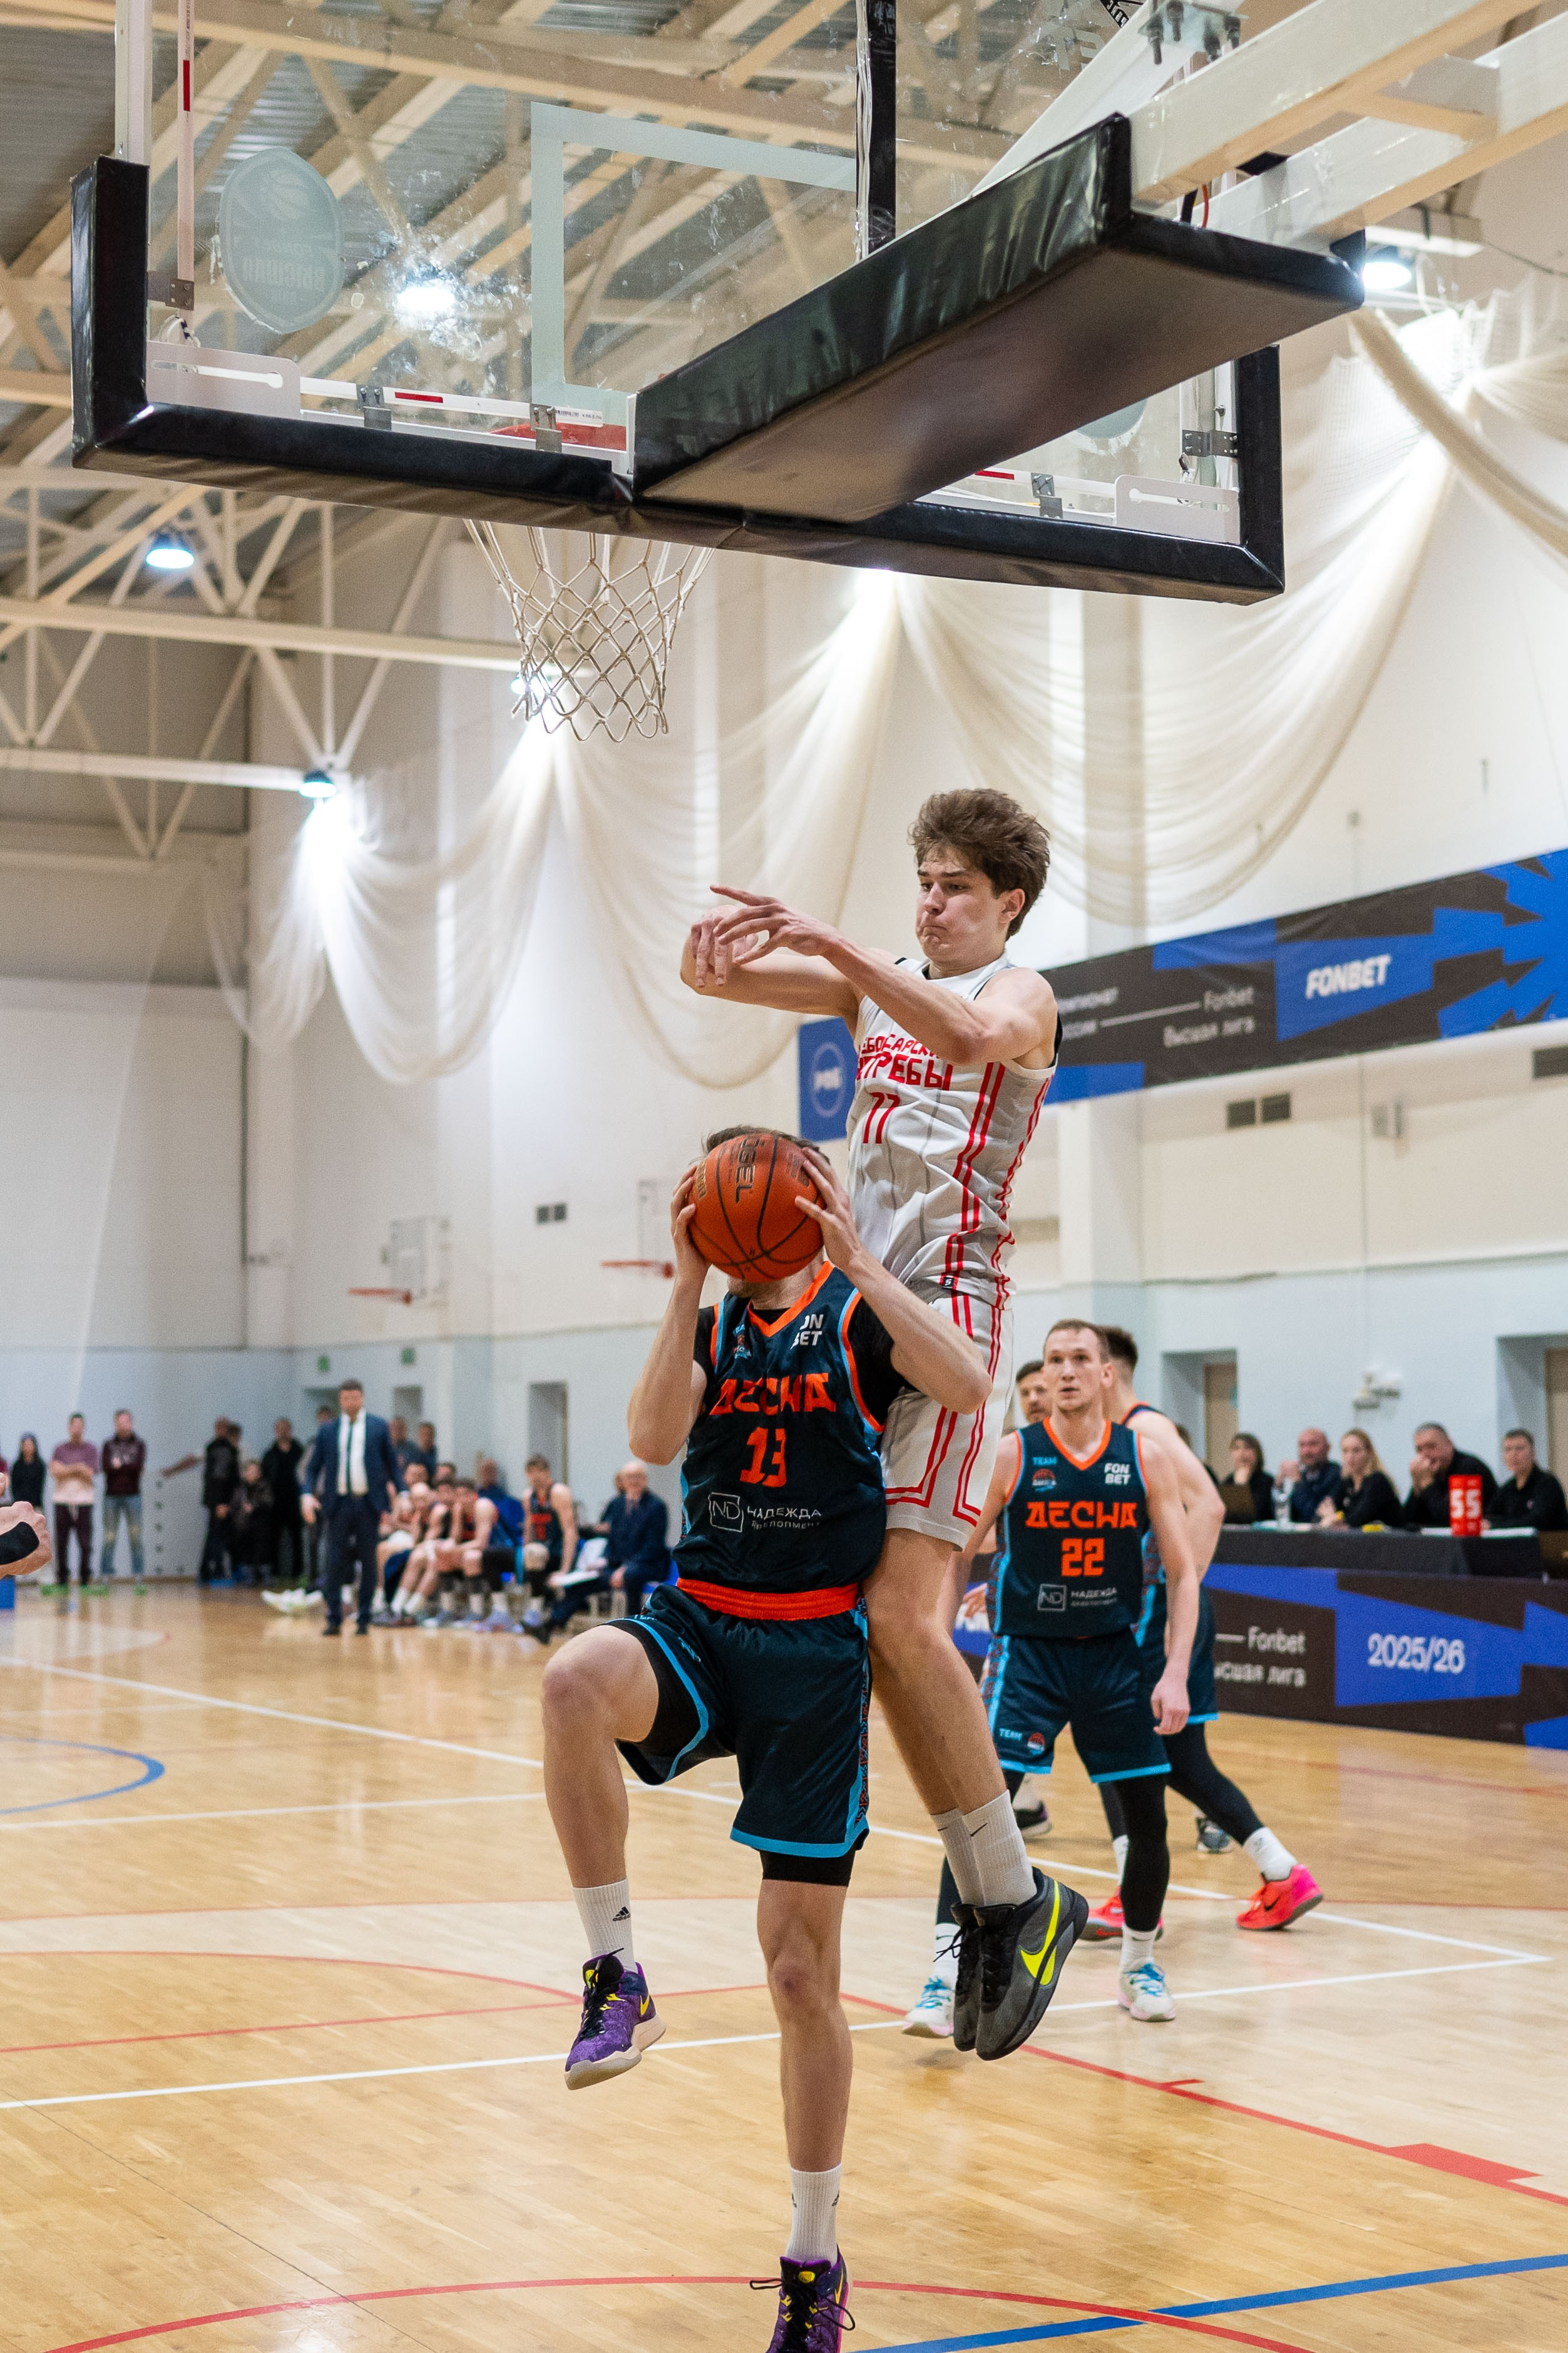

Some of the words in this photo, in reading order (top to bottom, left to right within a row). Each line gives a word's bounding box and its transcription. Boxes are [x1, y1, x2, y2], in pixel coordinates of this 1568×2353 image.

[1306, 954, 1390, 999] FONBET
[863, 1091, 901, 1144] 77
[710, 1372, 836, 1416] ДЕСНА
[739, 1426, 787, 1488] 13
[1032, 1456, 1058, 1466] TEAM
[1104, 1463, 1130, 1474] FON
[1104, 1473, 1131, 1485] BET
[713, 1500, 740, 1520] ND
[747, 1505, 822, 1520] НАДЕЖДА
[1025, 1501, 1137, 1529] ДЕСНА
[1061, 1537, 1105, 1577] 22
[1248, 1625, 1306, 1654] Fonbet
[1367, 1632, 1466, 1675] 2025/26
[1214, 1662, 1264, 1683] сшая
[1267, 1666, 1307, 1687] лига
